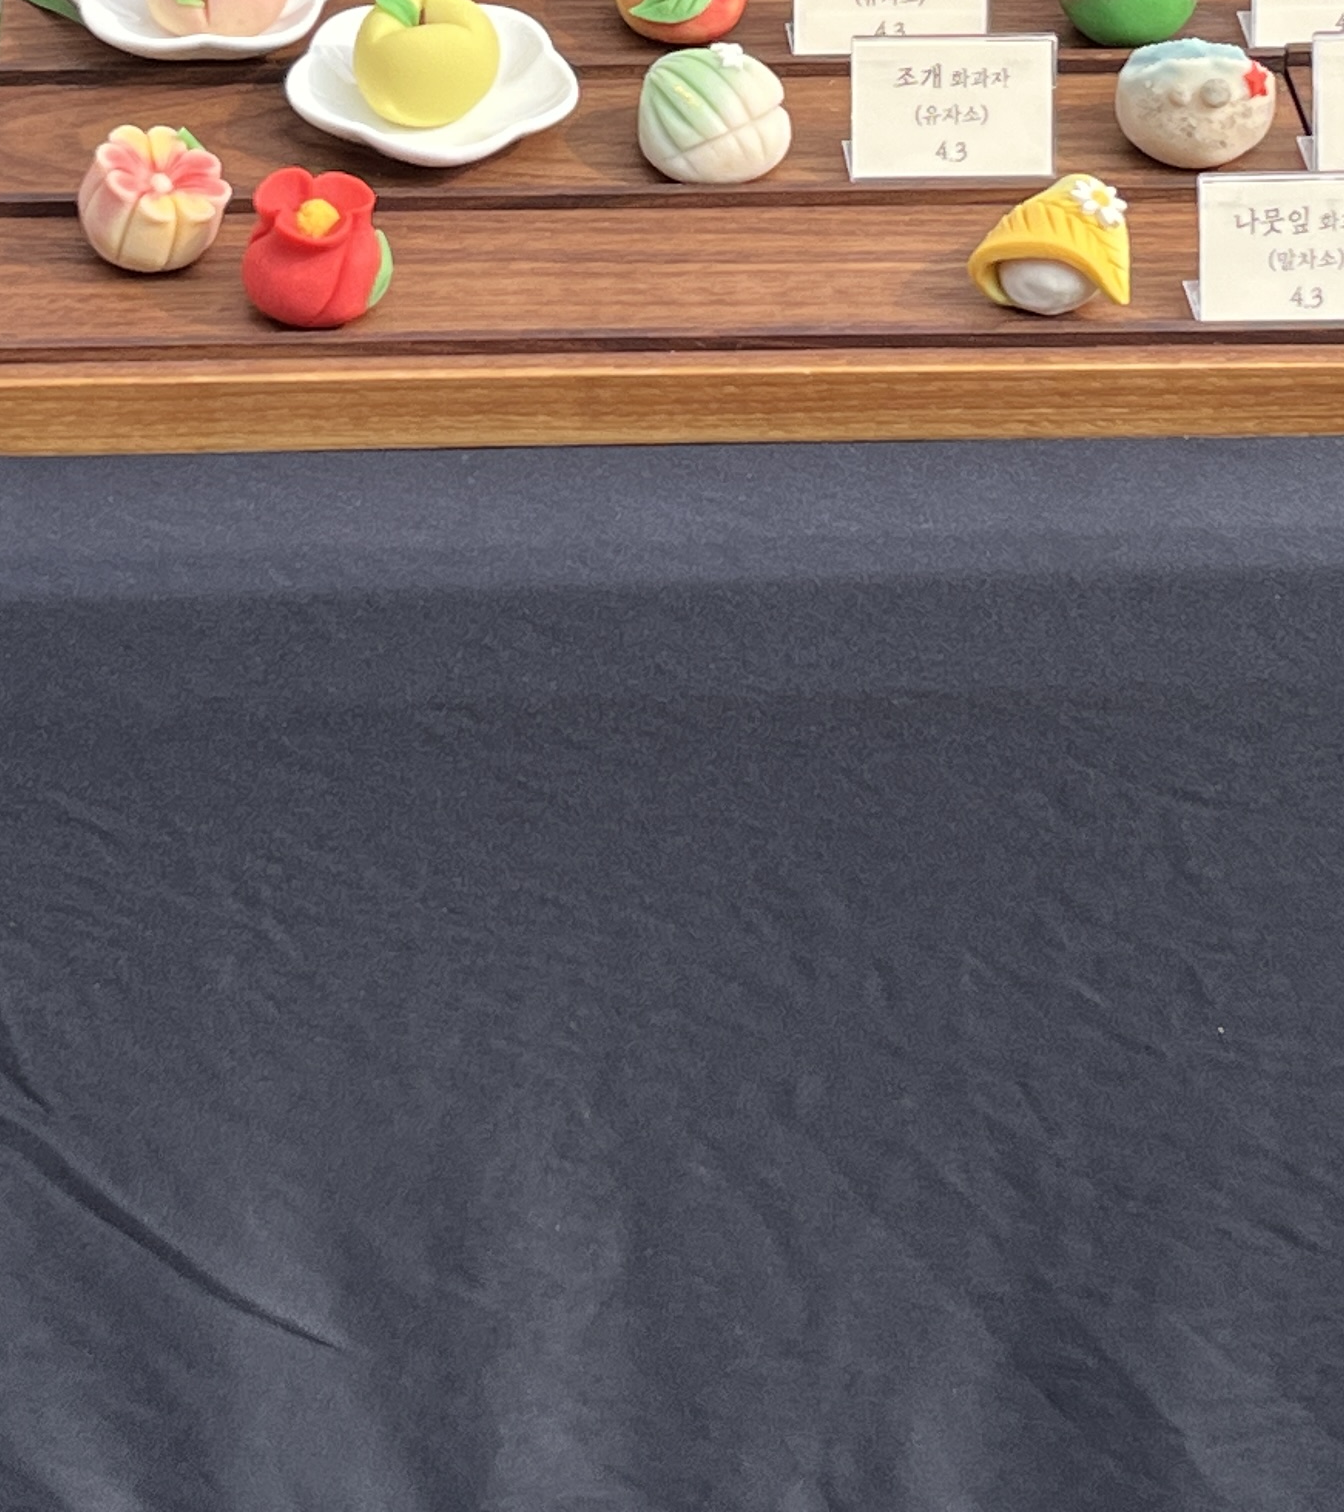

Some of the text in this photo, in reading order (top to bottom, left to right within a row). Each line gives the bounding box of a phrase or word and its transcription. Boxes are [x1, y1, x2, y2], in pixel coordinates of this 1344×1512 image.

[893, 63, 1010, 89] 조개 화과자
[935, 140, 967, 163] 4.3
[1234, 207, 1310, 236] 나뭇잎
[1289, 286, 1324, 309] 4.3
